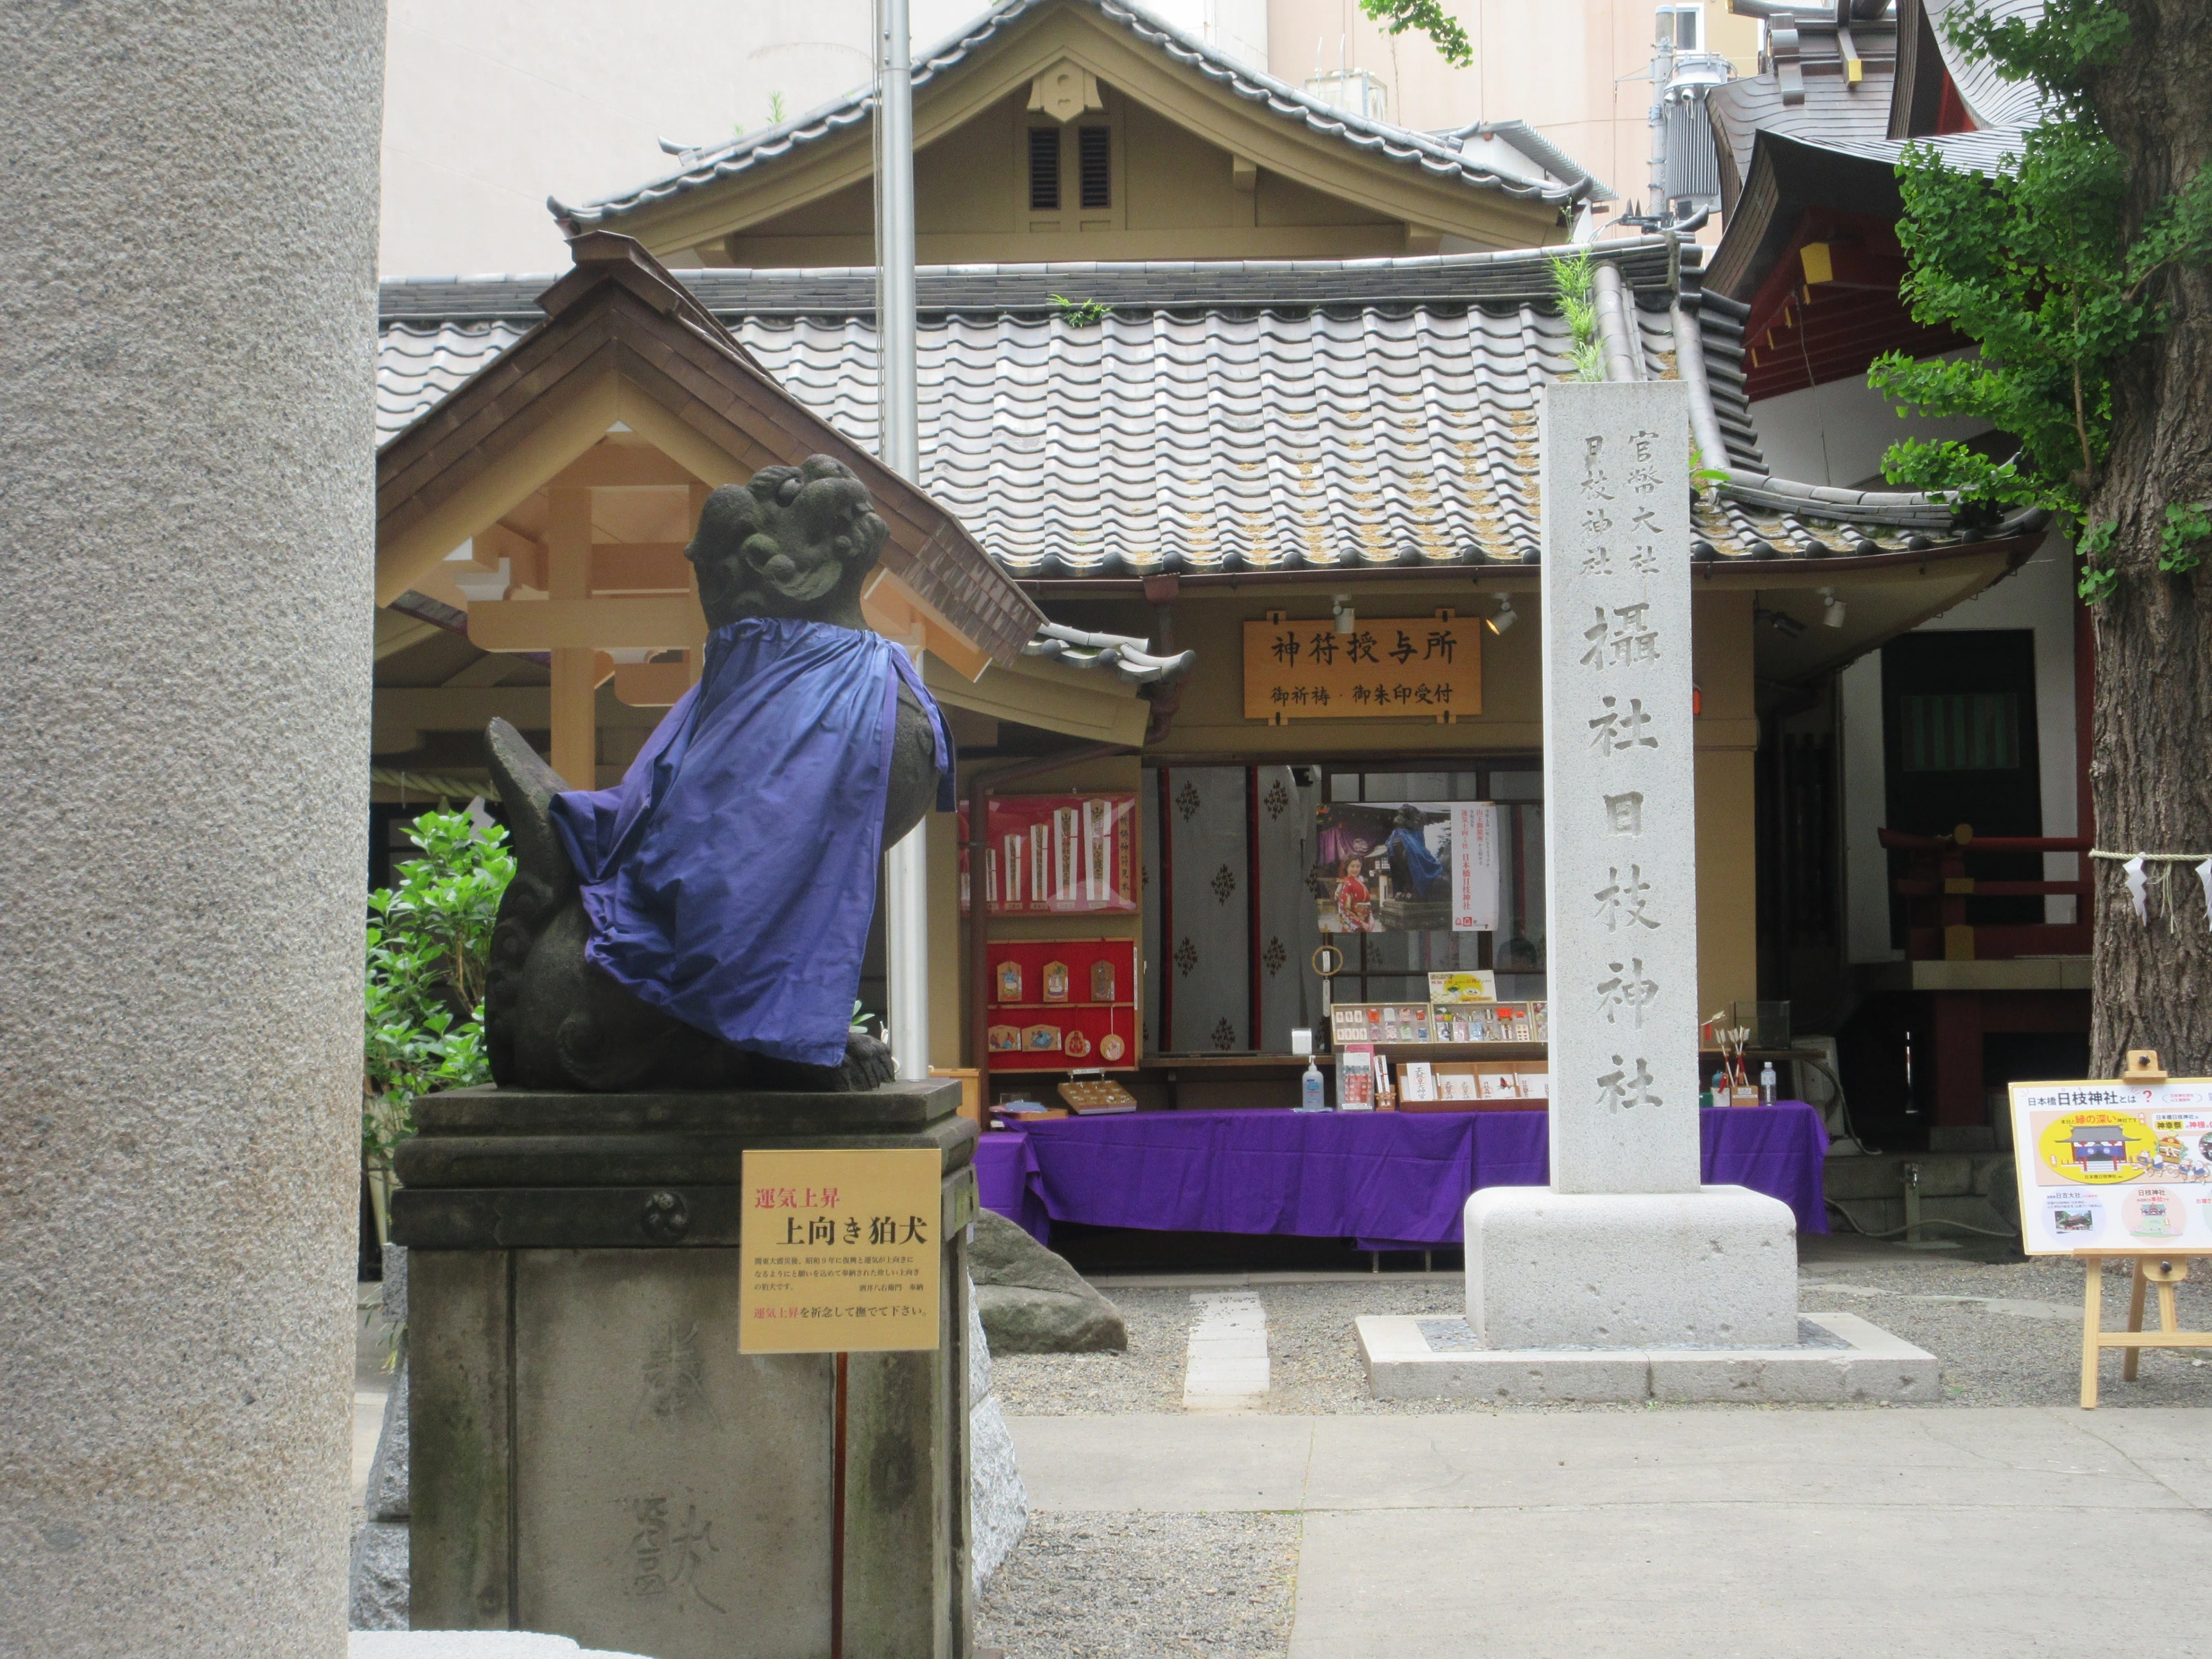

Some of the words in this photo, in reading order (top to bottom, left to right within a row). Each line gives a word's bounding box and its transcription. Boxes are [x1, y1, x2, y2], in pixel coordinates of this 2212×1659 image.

[1580, 435, 1615, 575] 日枝神社
[1271, 630, 1458, 668] 神符授与所
[2061, 1114, 2137, 1124] 本社と縁の深い神社です
[754, 1188, 841, 1209] 運気上昇
[776, 1216, 928, 1246] 上向き狛犬
[753, 1305, 927, 1318] 運気上昇を祈念して撫でて下さい。
